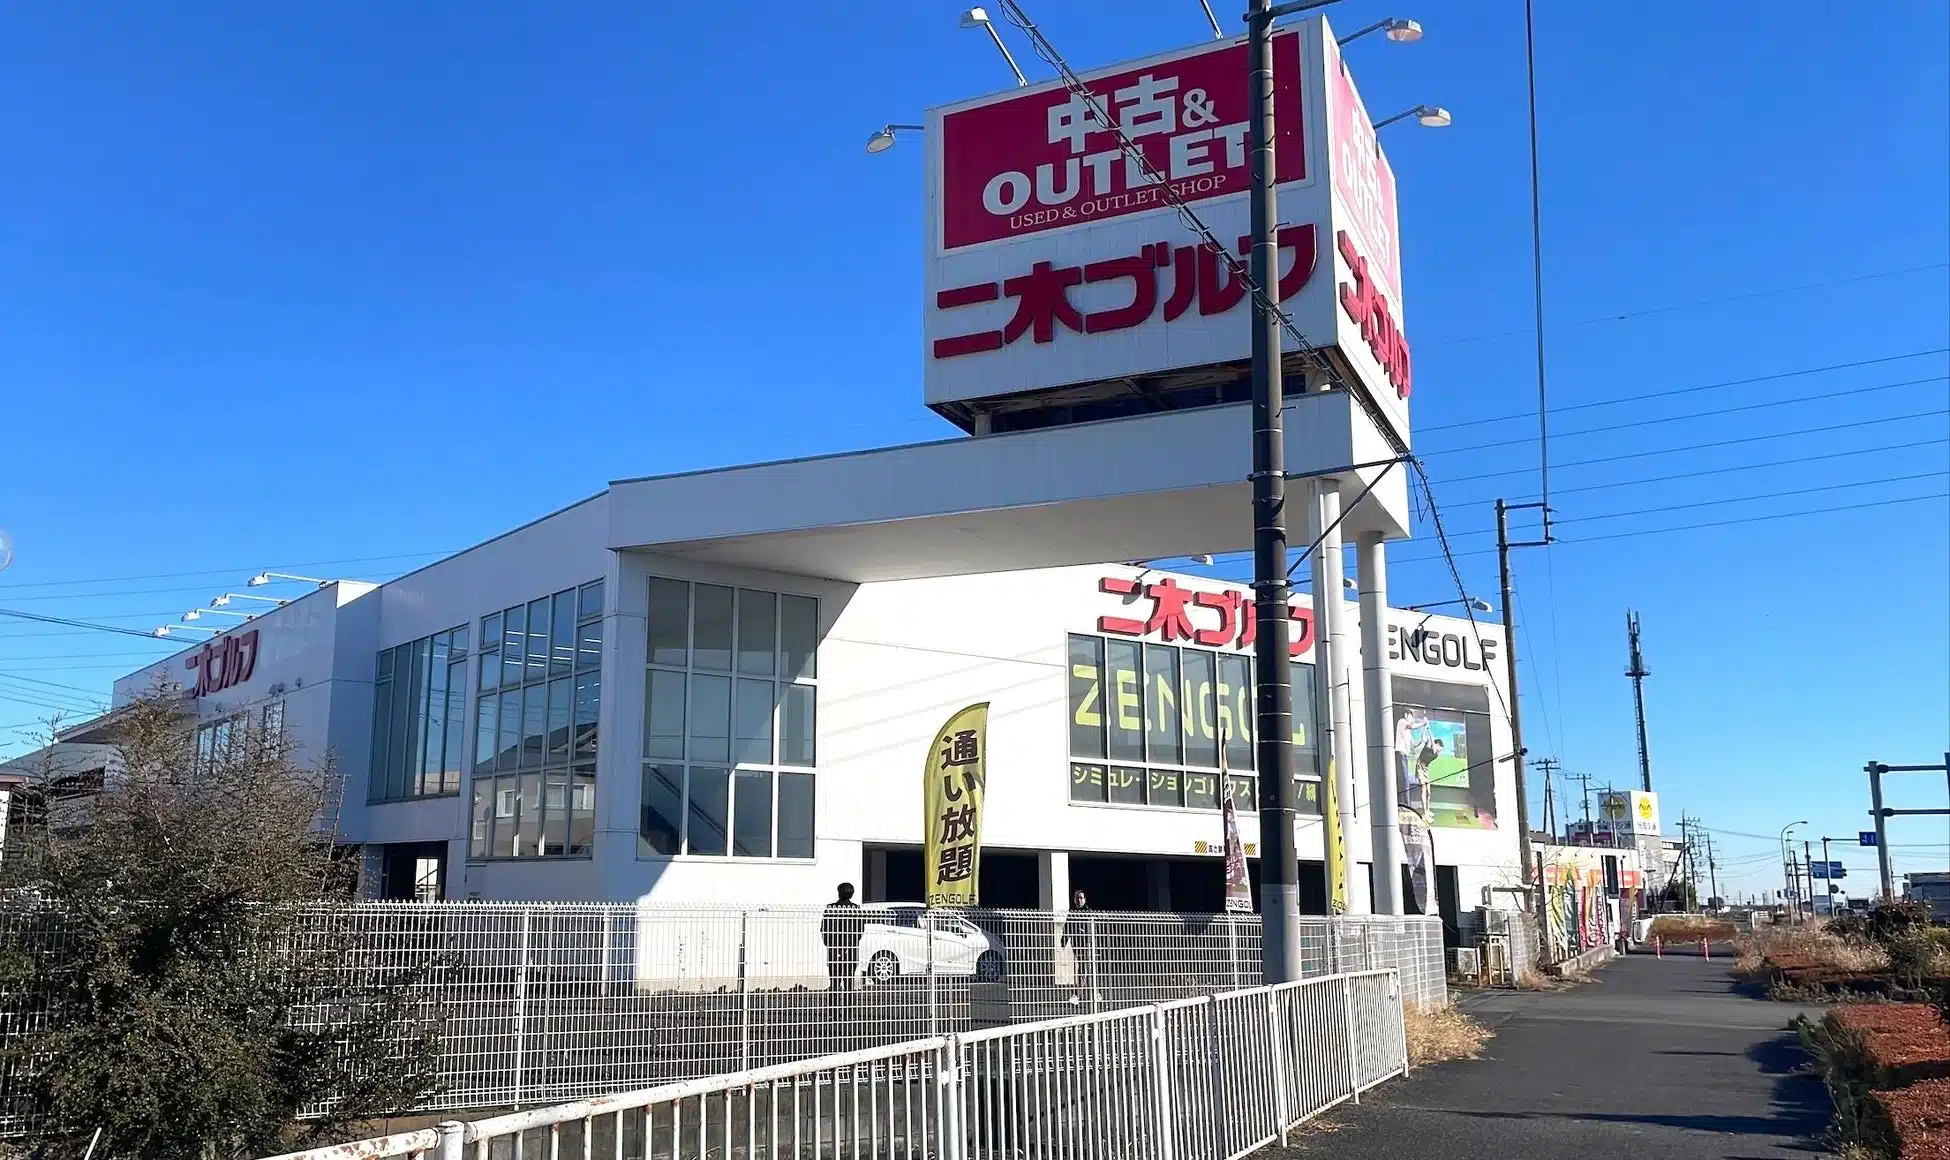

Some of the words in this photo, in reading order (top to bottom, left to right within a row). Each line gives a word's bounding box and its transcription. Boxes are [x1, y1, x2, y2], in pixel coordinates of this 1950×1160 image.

[1047, 73, 1220, 155] 中古&
[982, 120, 1251, 216] OUTLET
[1010, 208, 1060, 229] USED
[1062, 204, 1078, 219] &
[1080, 187, 1160, 216] OUTLET
[1168, 174, 1227, 199] SHOP
[933, 222, 1318, 359] 二木ゴルフ
[937, 729, 980, 886] 通い放題
[929, 893, 977, 906] ZENGOLF
